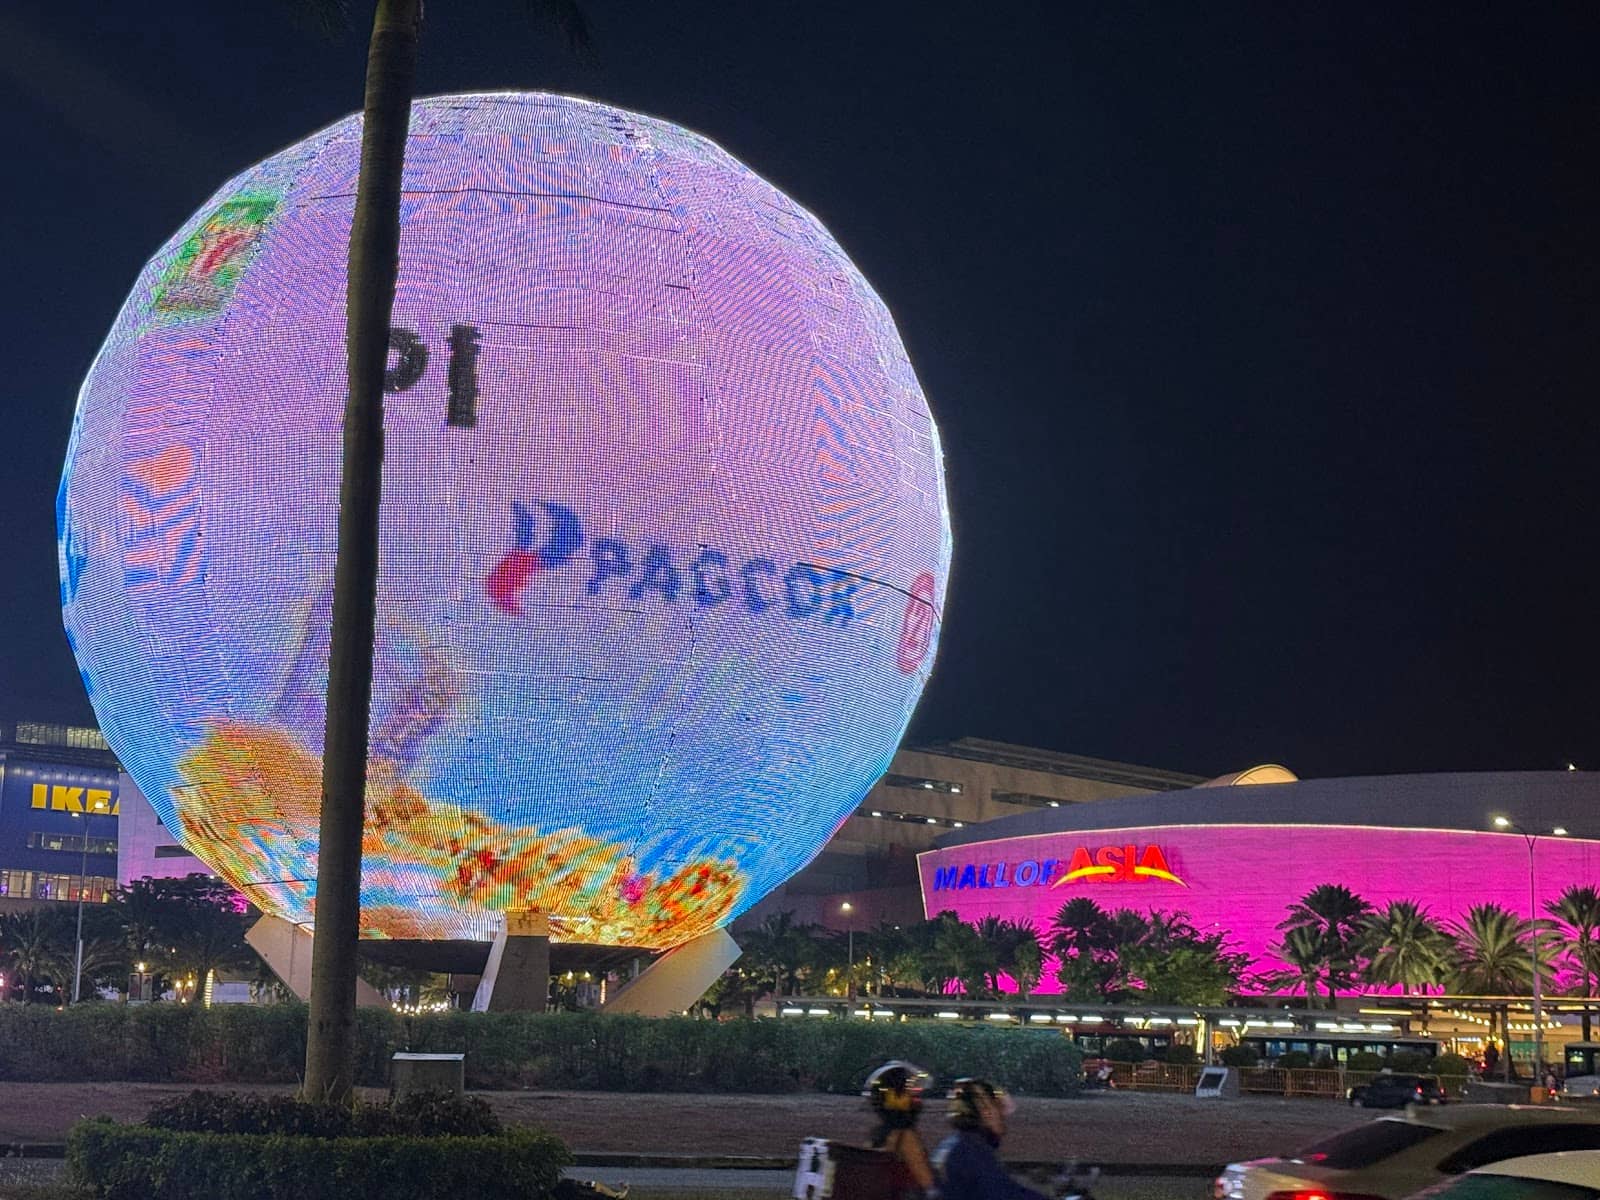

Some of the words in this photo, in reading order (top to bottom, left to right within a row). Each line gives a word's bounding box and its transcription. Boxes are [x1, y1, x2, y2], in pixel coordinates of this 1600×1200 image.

[586, 536, 857, 627] PAGCOR
[933, 861, 1009, 891] MALL
[1014, 859, 1060, 886] OF
[1068, 844, 1171, 884] ASIA
